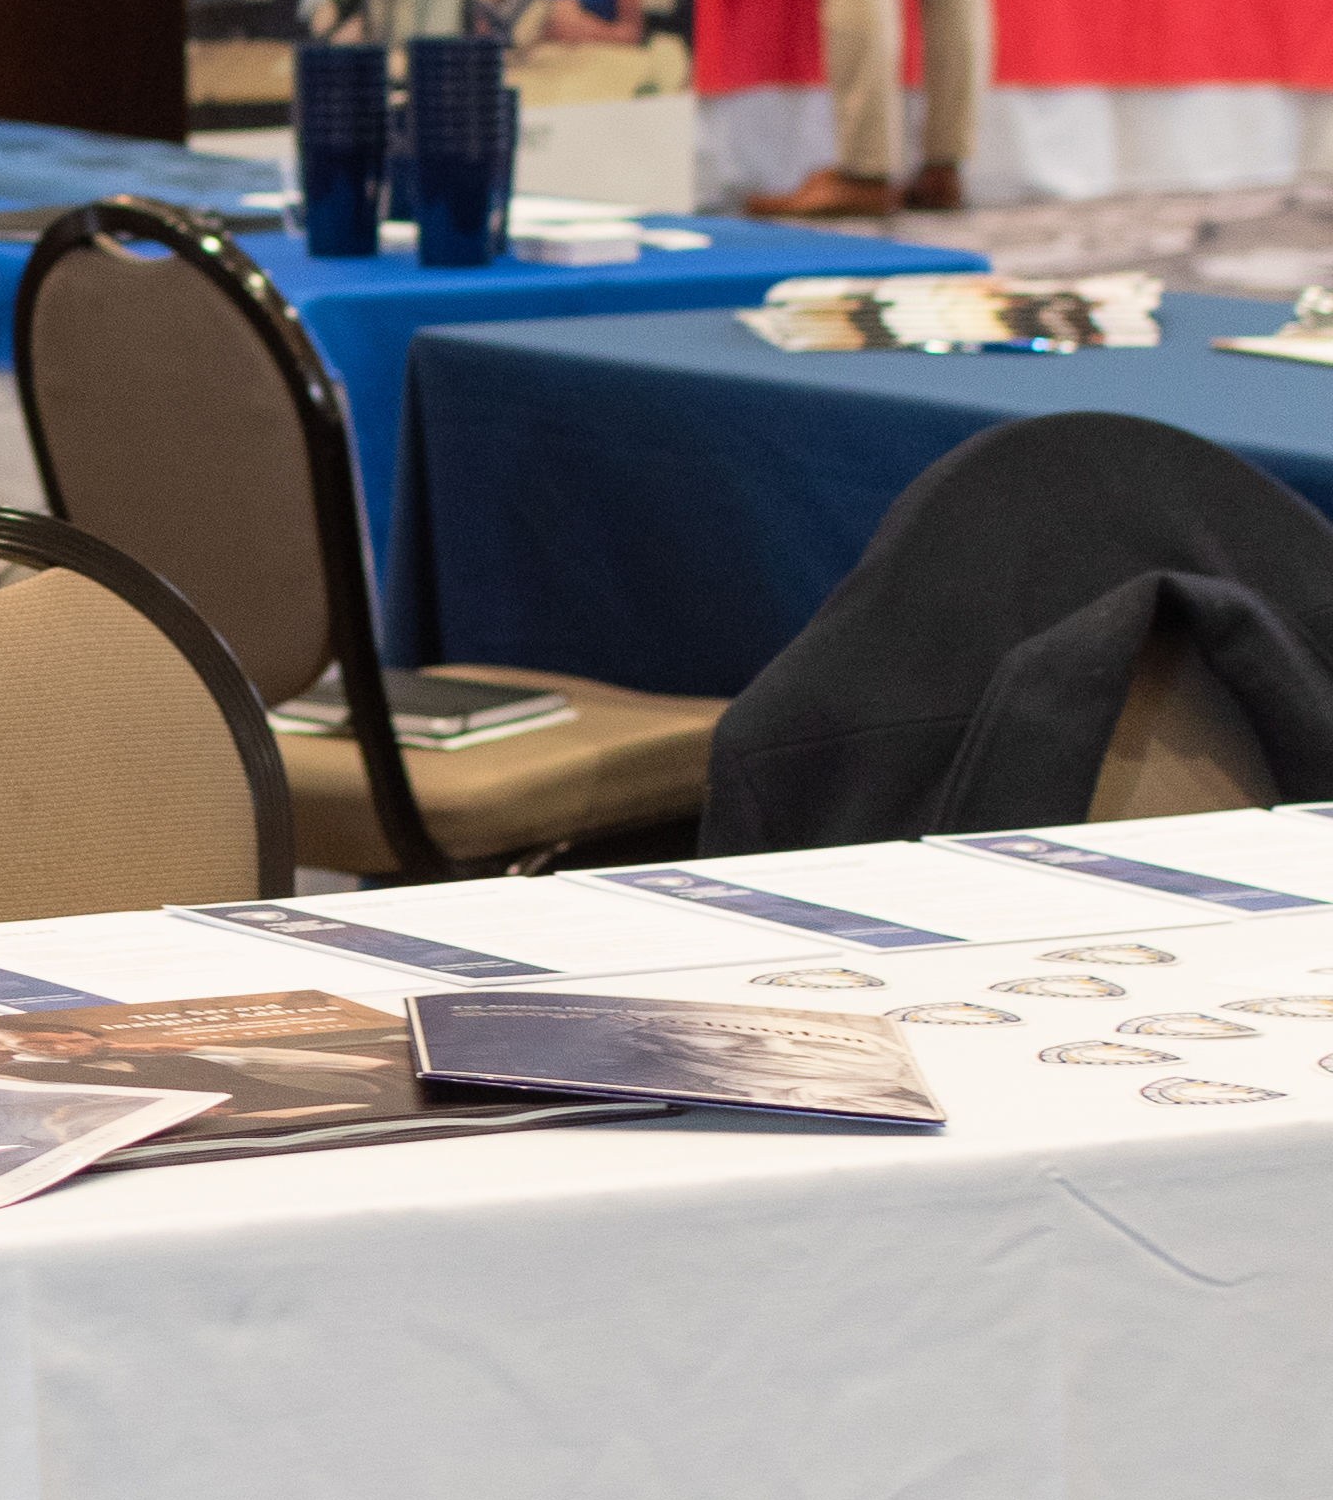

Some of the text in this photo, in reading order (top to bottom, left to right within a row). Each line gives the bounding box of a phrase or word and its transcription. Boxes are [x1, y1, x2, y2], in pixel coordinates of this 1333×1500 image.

[98, 1013, 230, 1031] Inaugural
[236, 1004, 342, 1020] Address
[127, 1003, 283, 1022] The Second
